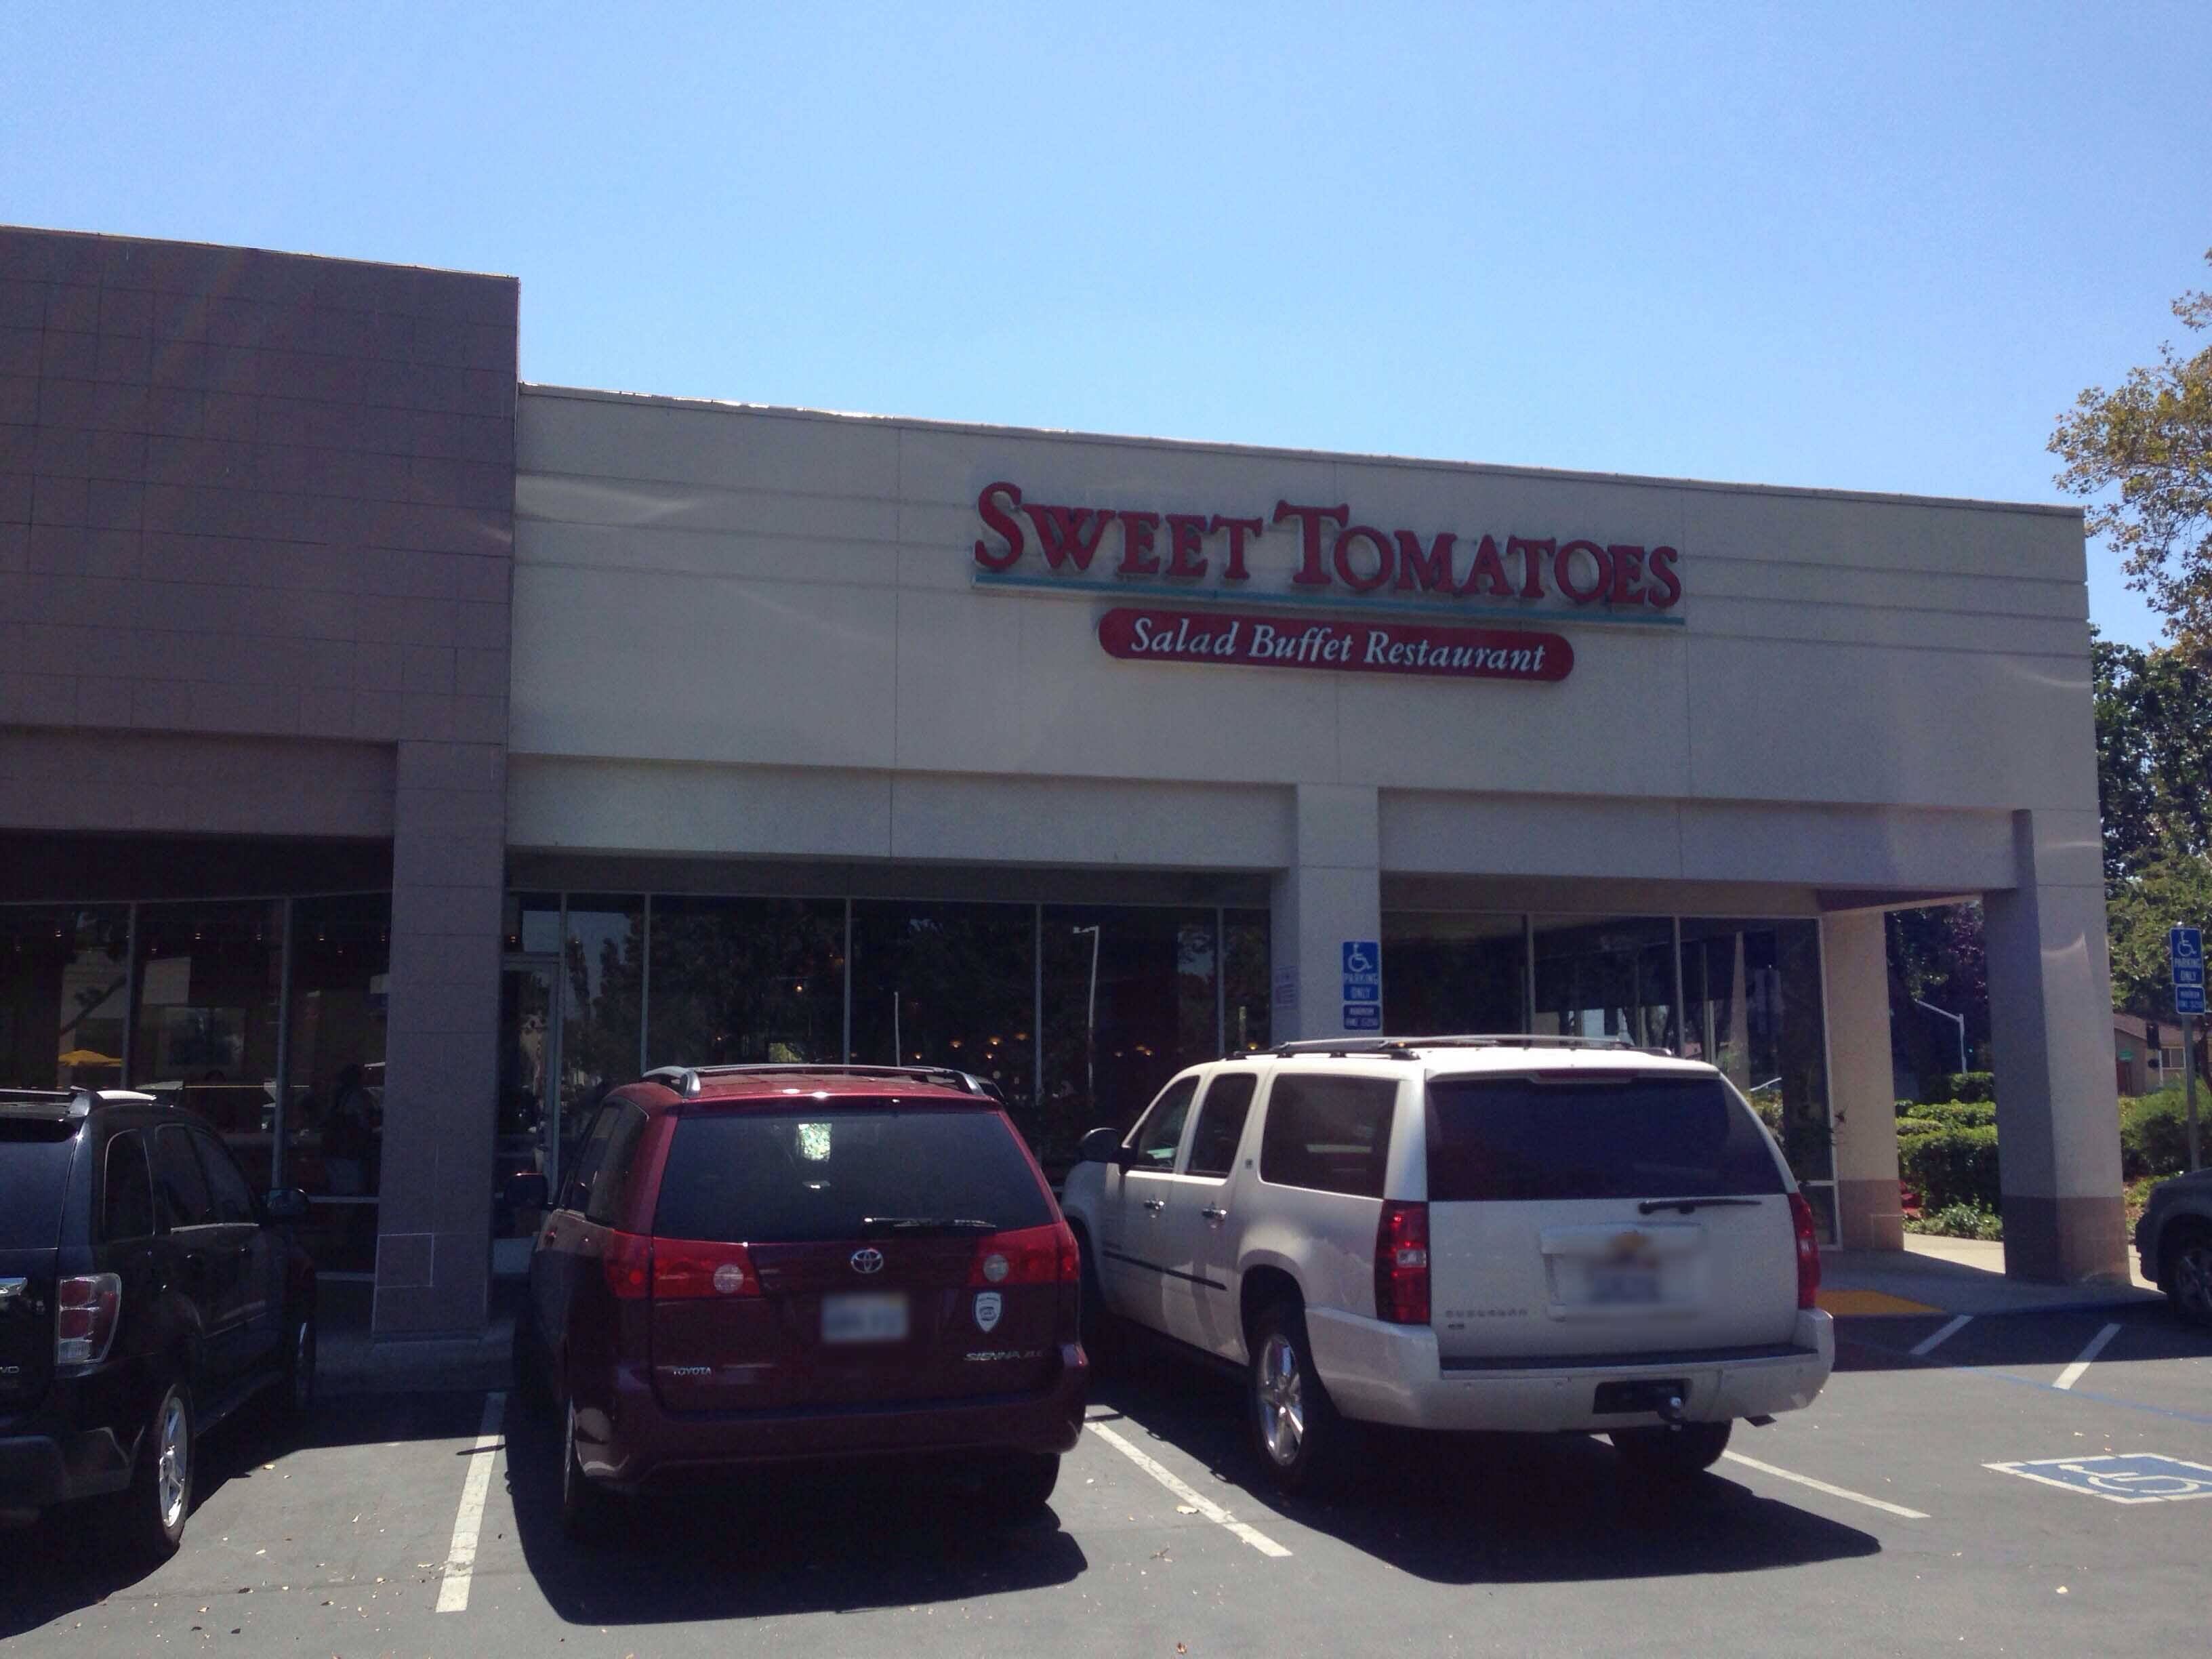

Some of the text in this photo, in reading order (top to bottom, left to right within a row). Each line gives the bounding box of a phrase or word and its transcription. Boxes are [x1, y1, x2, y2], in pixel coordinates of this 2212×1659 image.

[974, 481, 1681, 609] SWEET TOMATOES
[1130, 616, 1547, 674] Salad Buffet Restaurant
[2174, 958, 2202, 968] PARKING
[1344, 973, 1378, 985] PARKING
[1351, 986, 1372, 999] ONLY
[673, 1366, 712, 1376] TOYOTA
